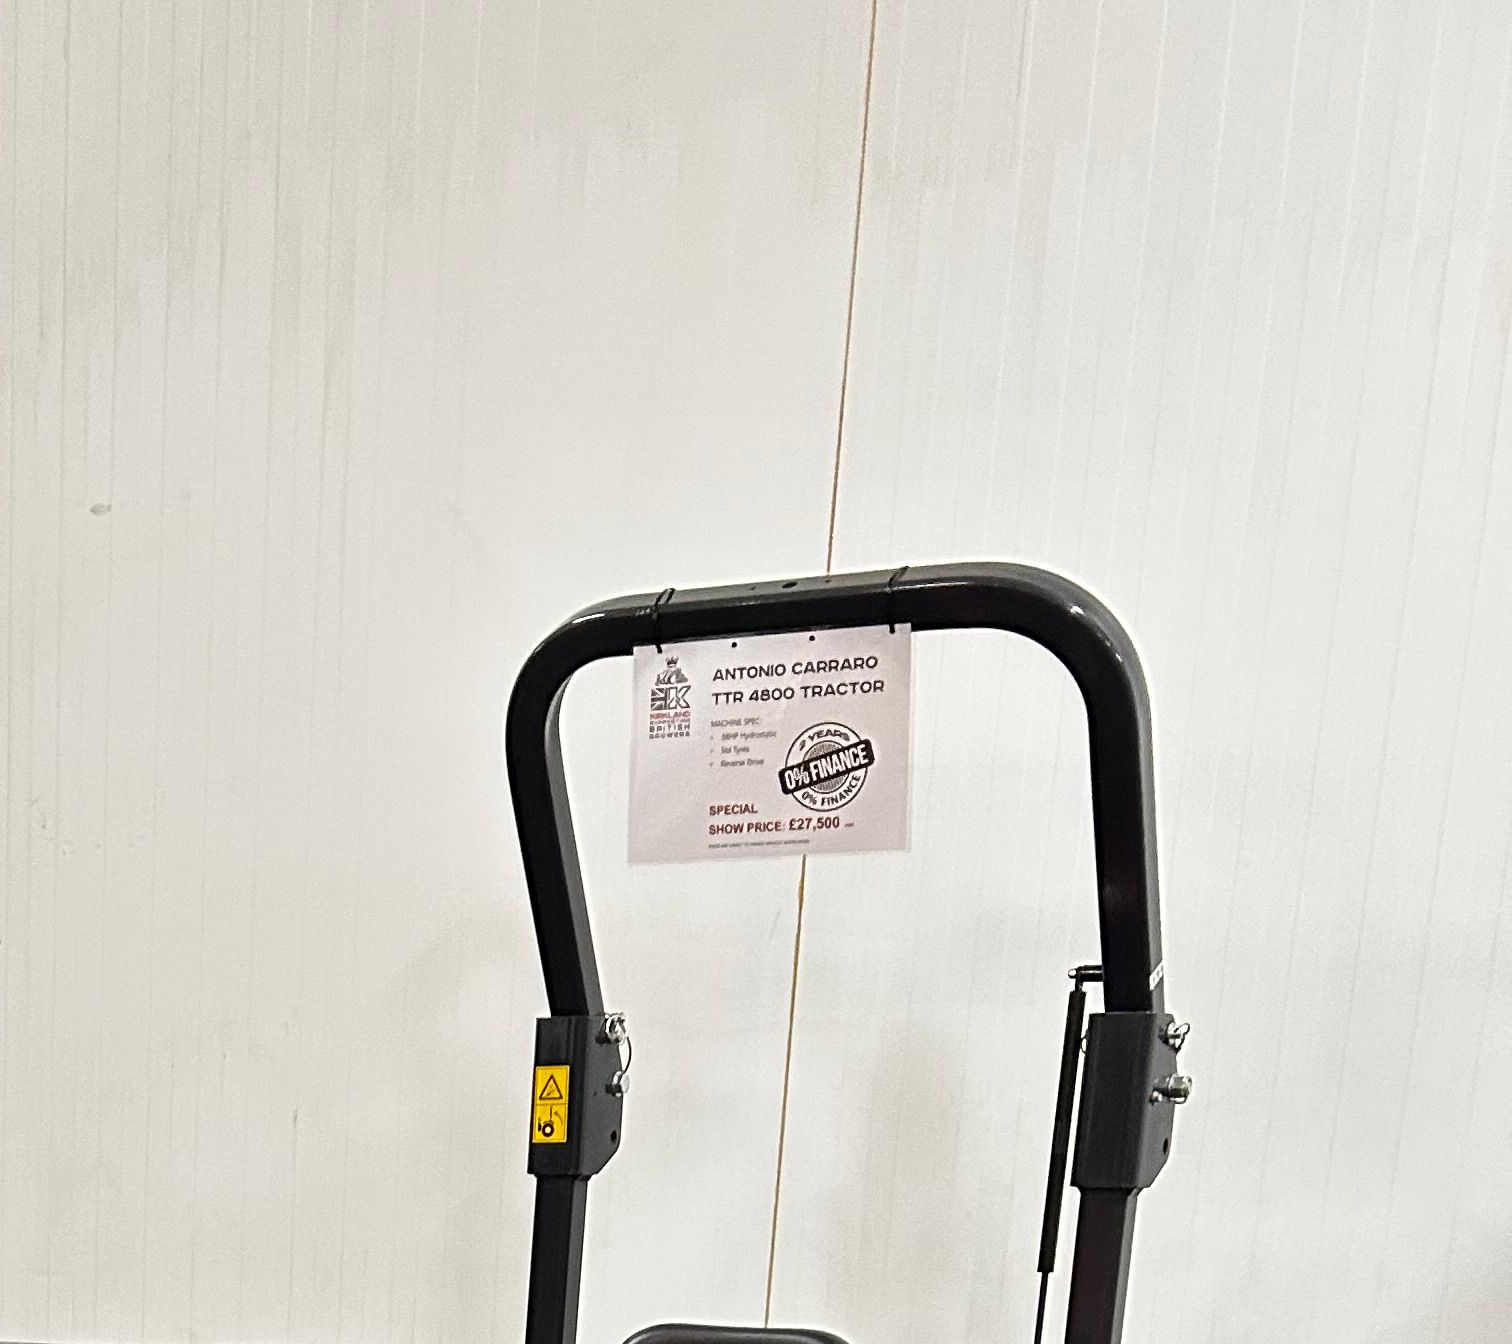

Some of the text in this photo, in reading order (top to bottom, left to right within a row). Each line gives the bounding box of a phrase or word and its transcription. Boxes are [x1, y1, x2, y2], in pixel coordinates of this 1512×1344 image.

[712, 656, 879, 682] ANTONIO CARRARO
[712, 680, 885, 705] TTR 4800 TRACTOR
[784, 743, 869, 790] 0% FINANCE
[820, 774, 862, 807] FINANCE
[709, 804, 758, 816] SPECIAL
[708, 822, 745, 836] SHOW
[788, 816, 841, 832] £27,500
